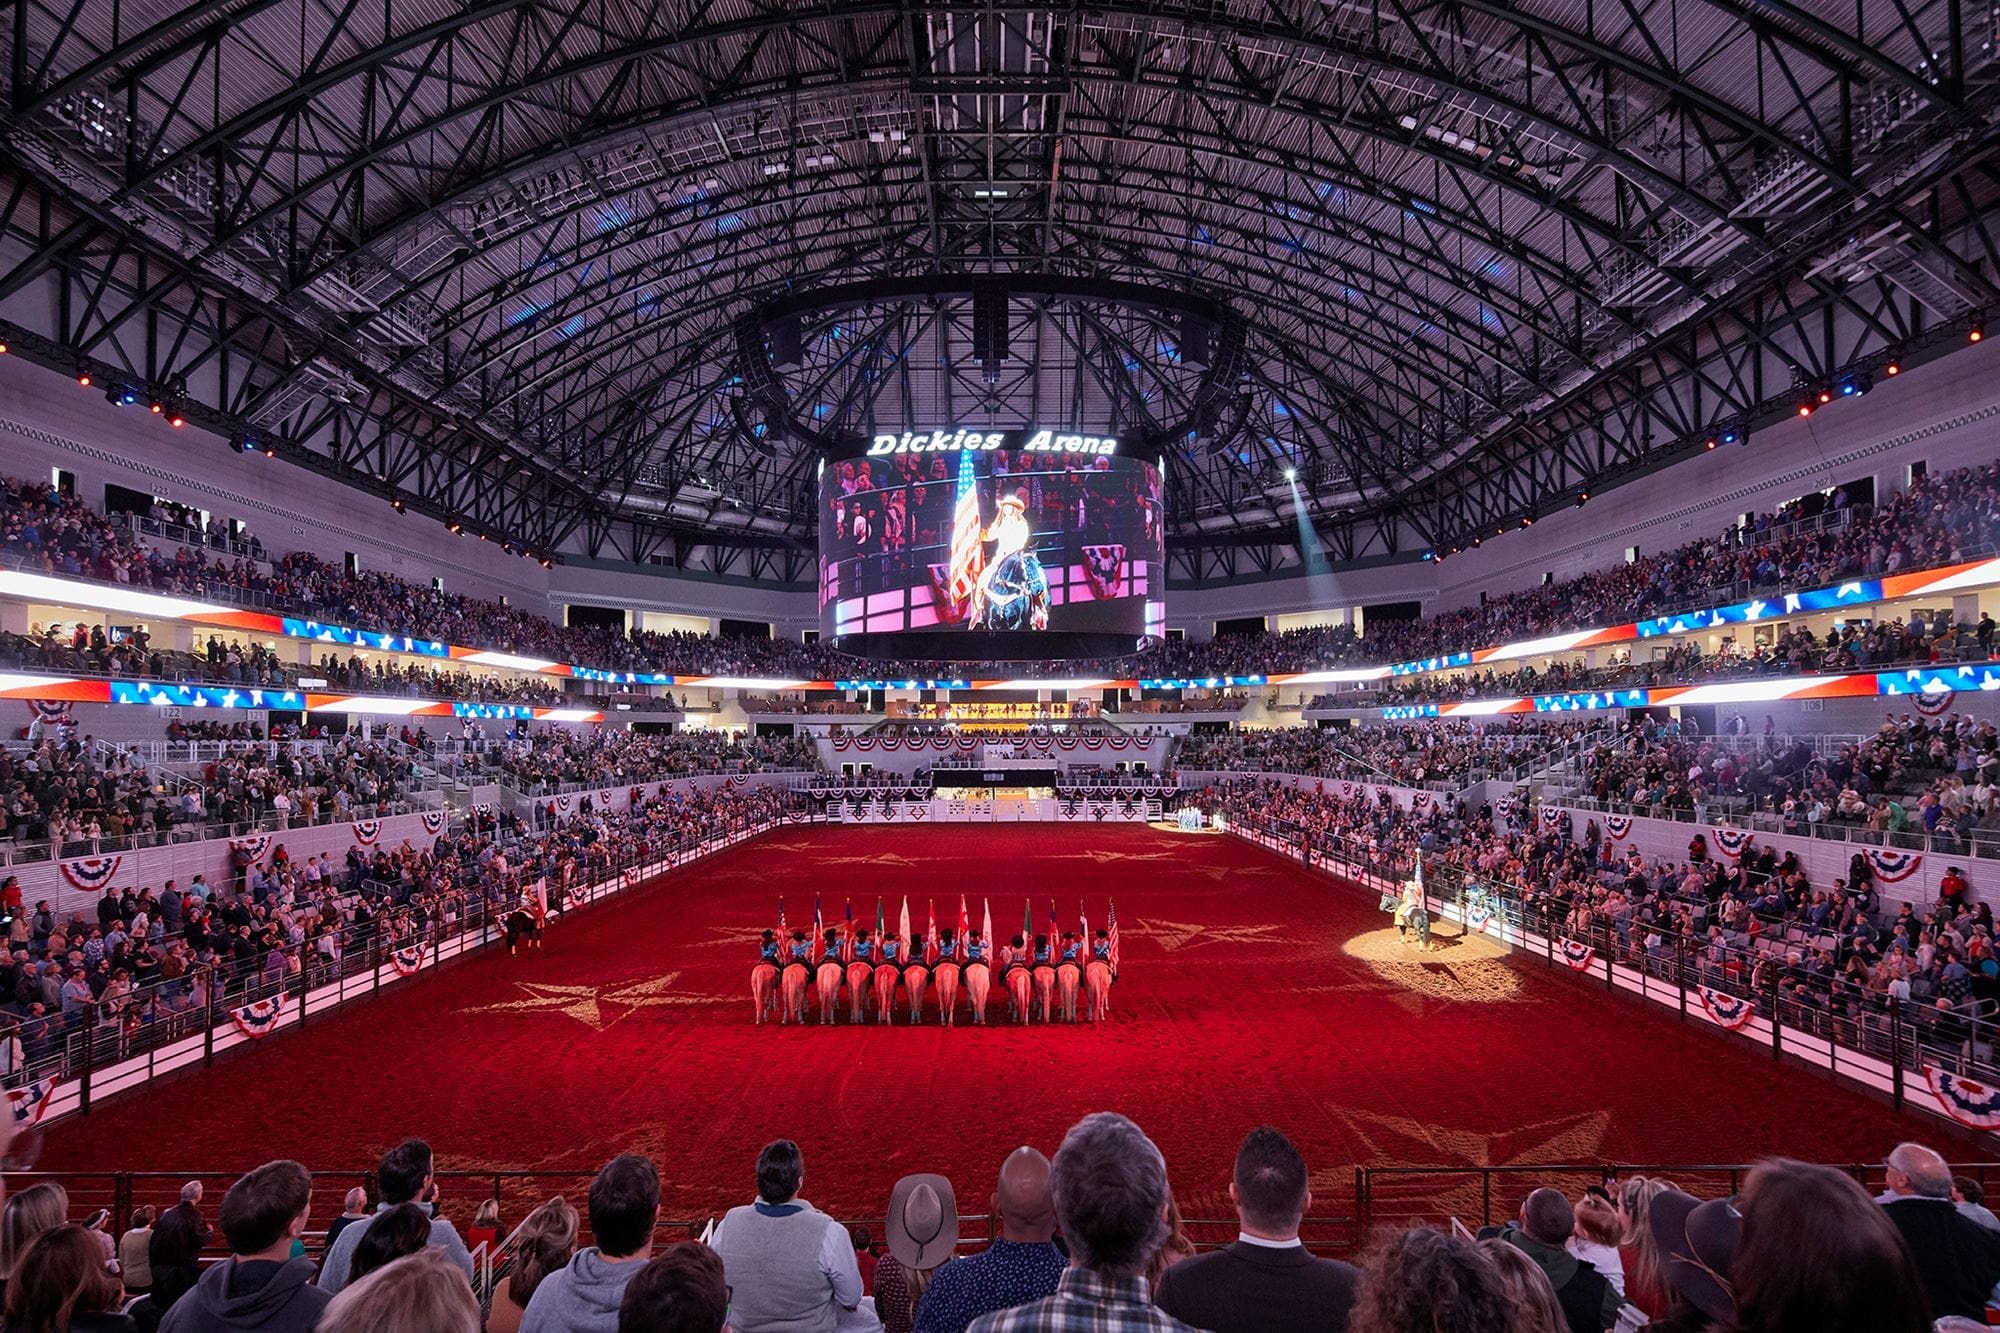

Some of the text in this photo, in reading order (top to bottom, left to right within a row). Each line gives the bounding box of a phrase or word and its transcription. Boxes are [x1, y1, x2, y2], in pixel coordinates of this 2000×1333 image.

[866, 429, 1118, 456] Dickies Arena
[1814, 477, 1829, 489] 207
[153, 484, 169, 496] 223
[1804, 700, 1821, 711] 108
[163, 707, 180, 718] 122
[249, 710, 264, 720] 123
